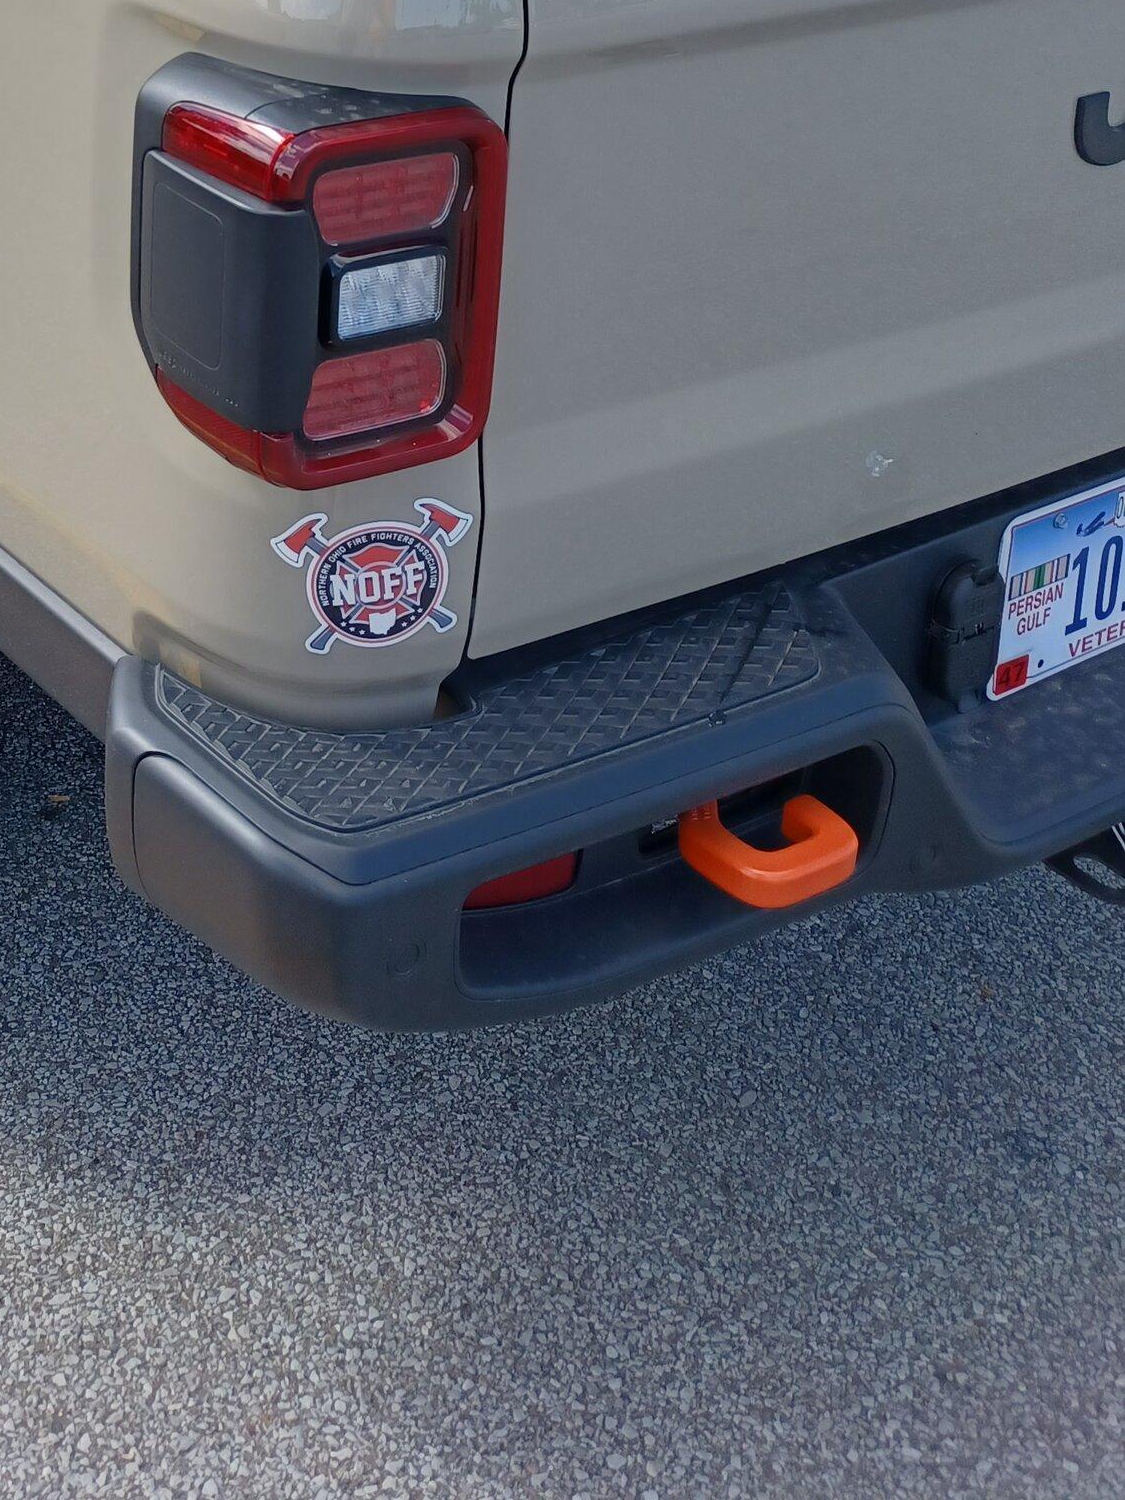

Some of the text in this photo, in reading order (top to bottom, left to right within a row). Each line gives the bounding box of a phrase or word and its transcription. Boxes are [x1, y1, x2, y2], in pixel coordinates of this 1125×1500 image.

[316, 532, 439, 607] NORTHERN OHIO FIRE FIGHTERS ASSOCIATION
[329, 560, 426, 607] NOFF
[1064, 535, 1125, 636] 10
[1007, 582, 1065, 620] PERSIAN
[1016, 607, 1052, 636] GULF
